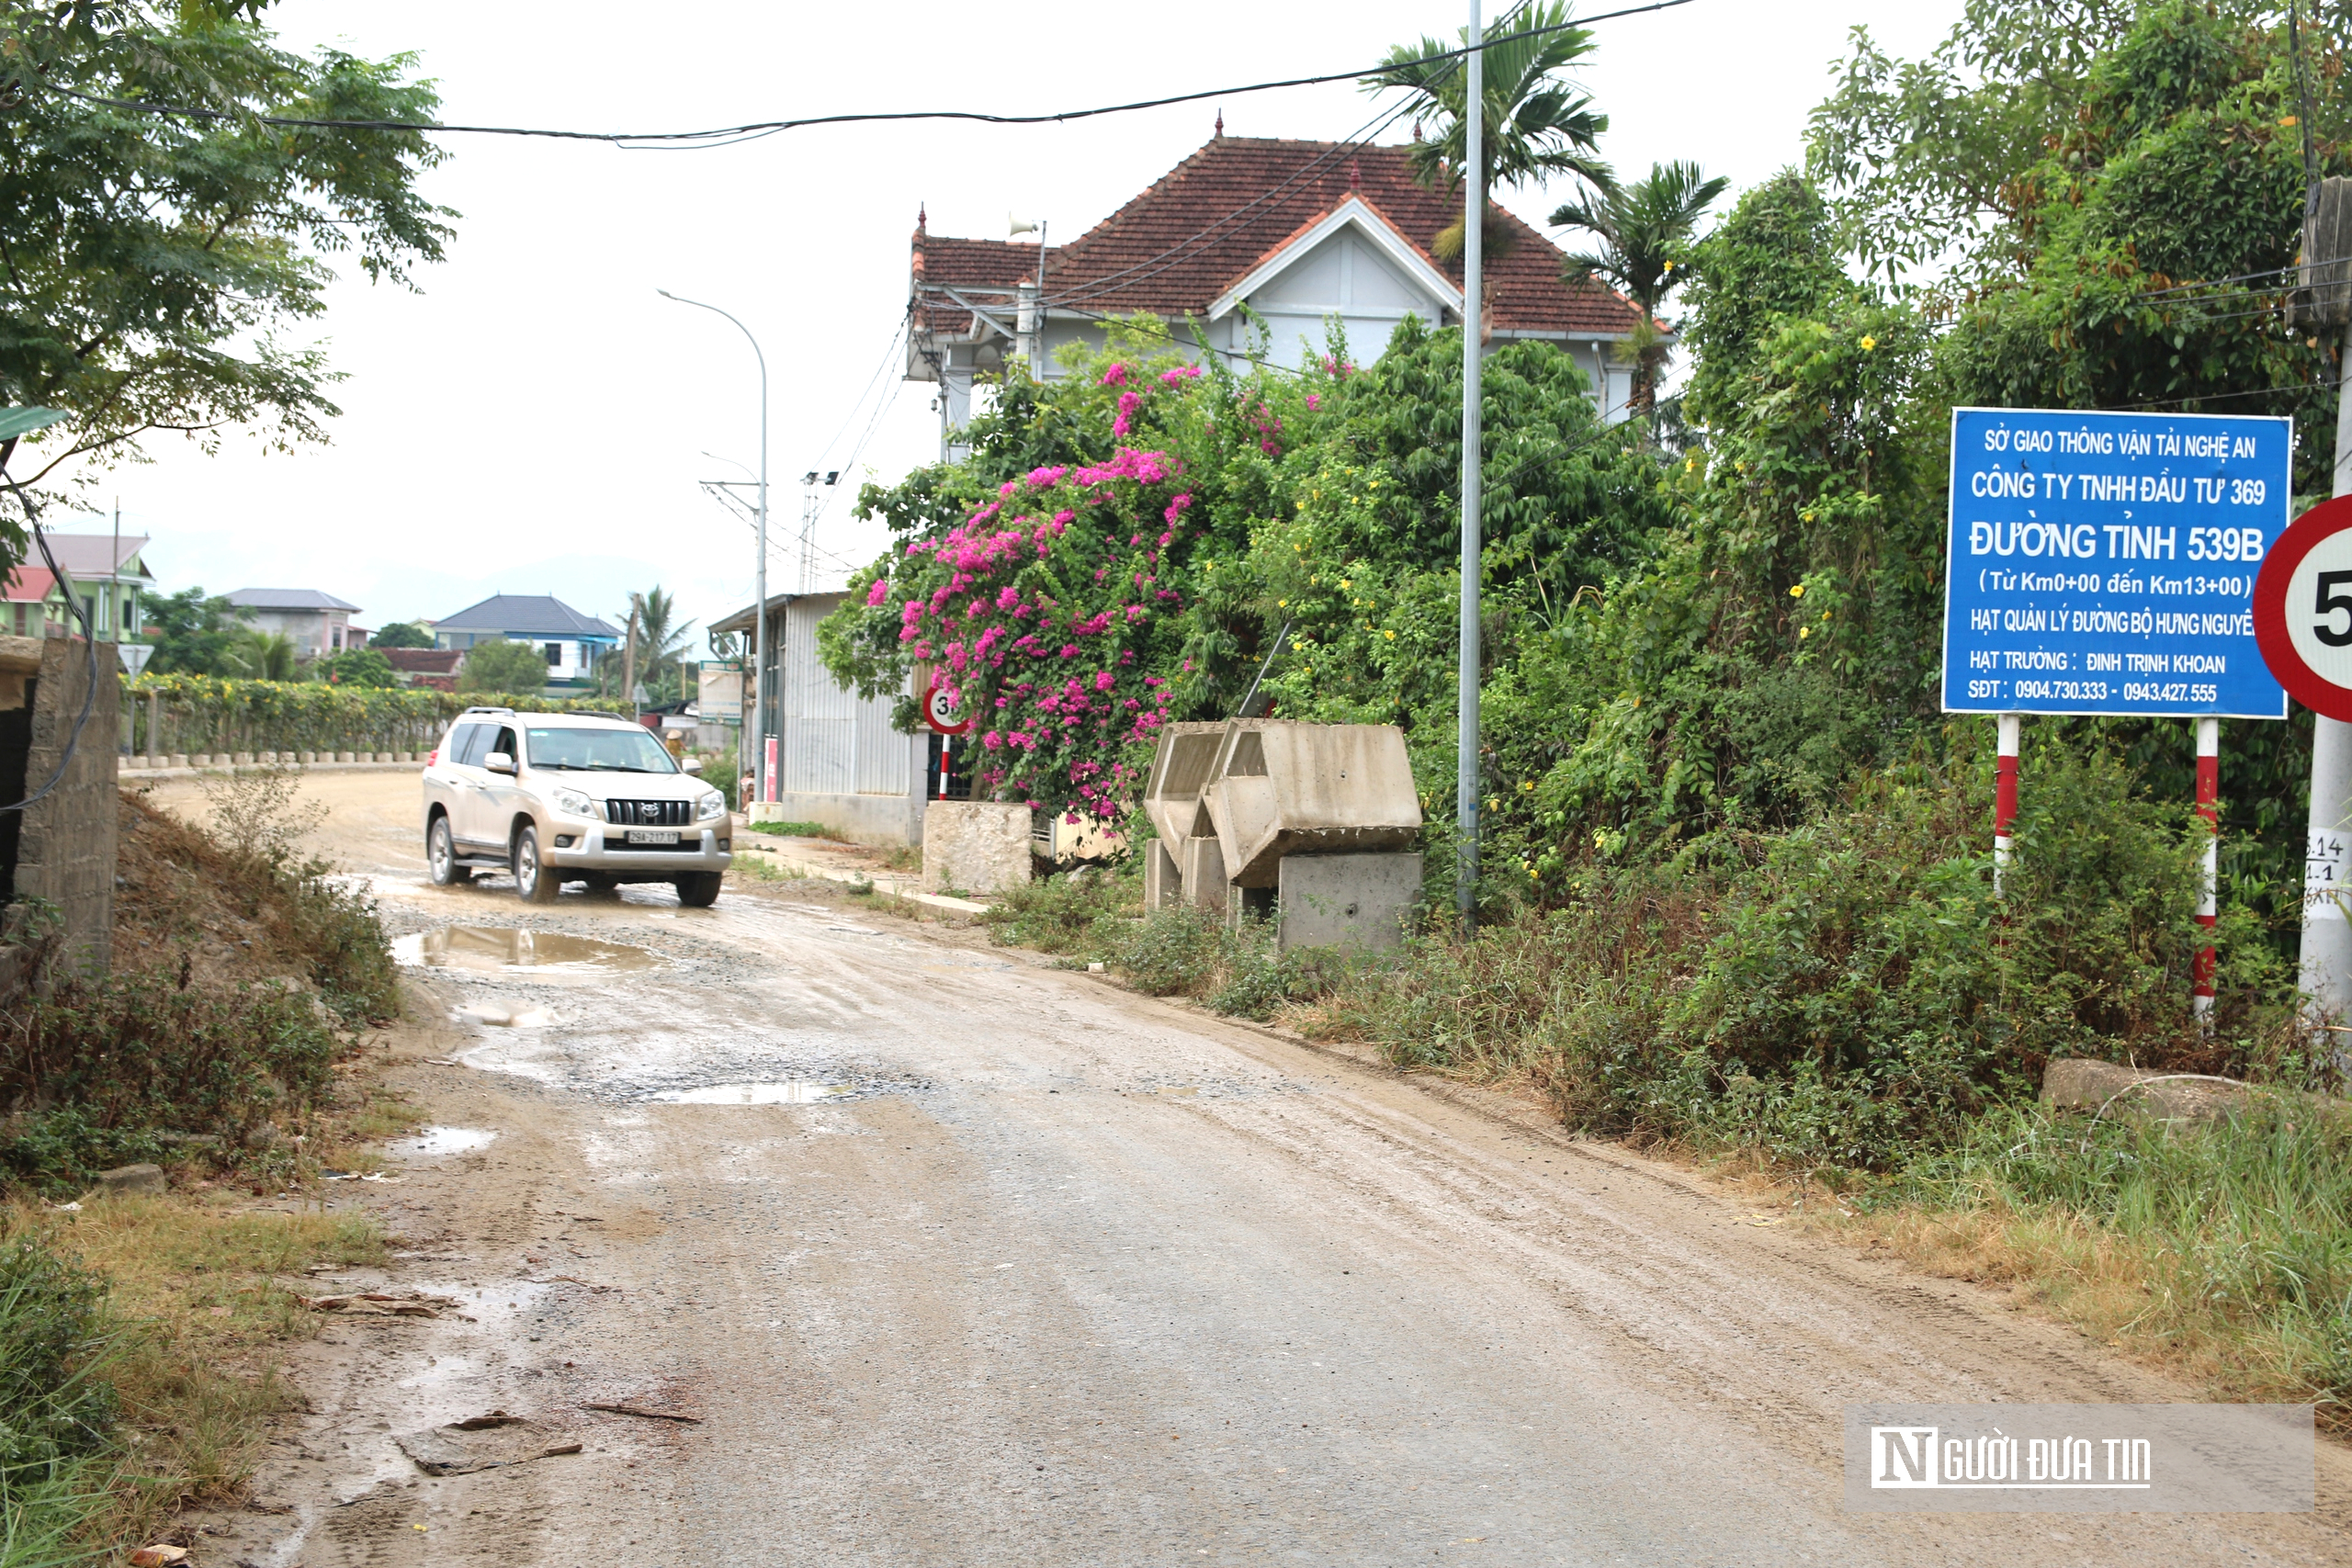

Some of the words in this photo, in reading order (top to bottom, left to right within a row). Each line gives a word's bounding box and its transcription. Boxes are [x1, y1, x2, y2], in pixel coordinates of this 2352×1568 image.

[1984, 422, 2010, 451] SỞ
[2014, 430, 2053, 453] GIAO
[2057, 425, 2113, 455] THÔNG
[2118, 429, 2151, 461] VẬN
[2155, 426, 2180, 456] TẢI
[2185, 432, 2230, 464] NGHỆ
[2232, 436, 2256, 458] AN
[1971, 463, 2036, 499] CÔNG
[2042, 473, 2074, 500] TY
[2078, 475, 2137, 502] TNHH
[2140, 467, 2187, 503] ĐẦU
[2193, 478, 2226, 504] TƯ
[2230, 479, 2266, 505] 369
[1968, 510, 2097, 558] ĐƯỜNG
[2102, 510, 2177, 560] TỈNH
[2187, 526, 2264, 561] 539B
[2021, 571, 2100, 592] Km0+00
[2107, 568, 2143, 593] đến
[2150, 574, 2251, 599] Km13+00)
[1971, 608, 2001, 636] HẠT
[2004, 602, 2046, 633] QUẢN
[2050, 602, 2070, 631] LÝ
[2072, 602, 2129, 633] ĐƯỜNG
[2131, 606, 2153, 640] BỘ
[2155, 612, 2199, 635] HƯNG
[2201, 608, 2256, 637] NGUYÊ
[2313, 570, 2352, 647] 5
[1970, 650, 2000, 673] HẠT
[2086, 653, 2121, 671] ĐINH
[2125, 653, 2168, 677] TRỊNH
[2173, 655, 2225, 673] KHOAN
[936, 696, 956, 716] 3
[2015, 680, 2108, 700] 0904.730.333
[2123, 682, 2217, 703] 0943.427.555
